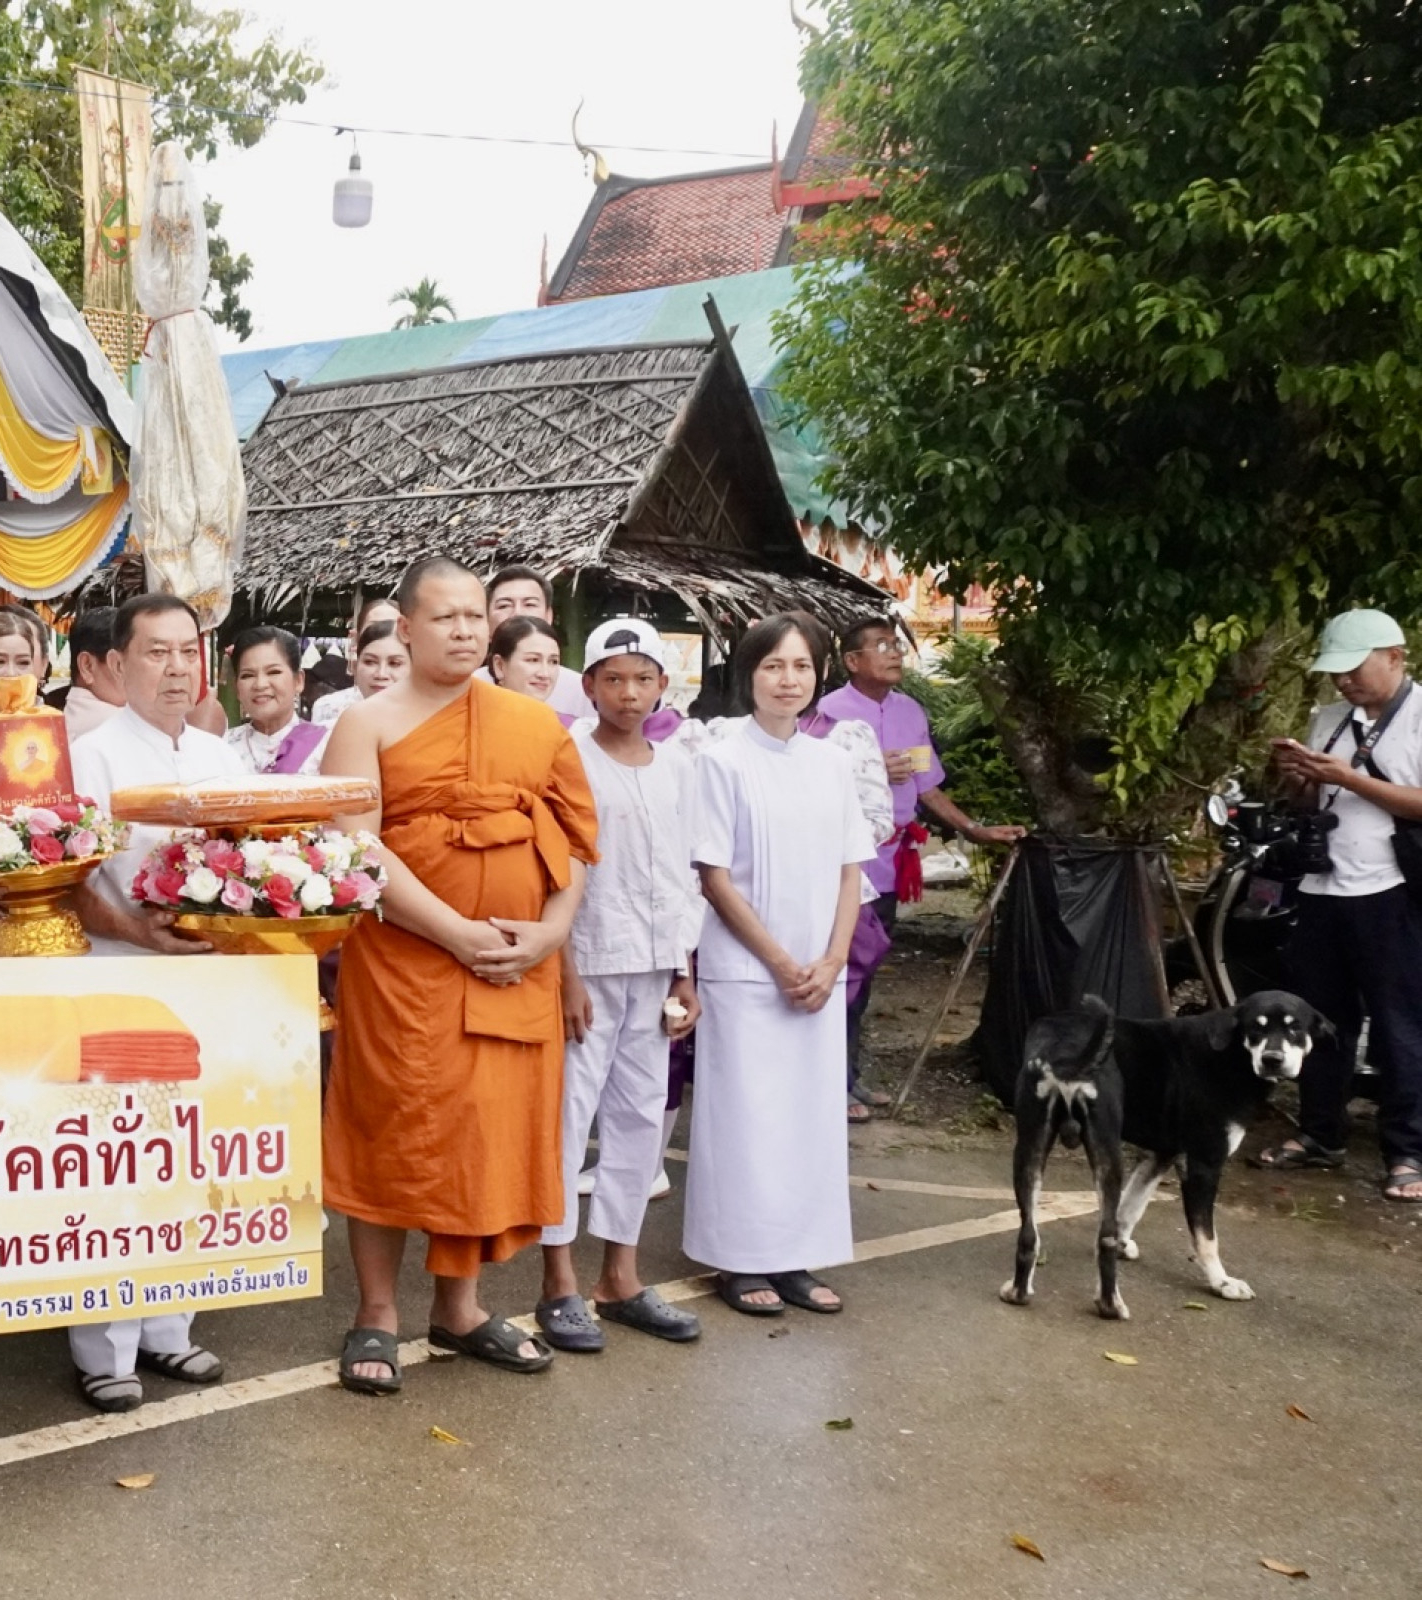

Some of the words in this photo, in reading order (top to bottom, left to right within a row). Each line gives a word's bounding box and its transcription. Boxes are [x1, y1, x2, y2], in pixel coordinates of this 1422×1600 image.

[197, 1208, 289, 1249] 2568
[82, 1288, 109, 1310] 81
[118, 1281, 135, 1308] ปี
[143, 1265, 308, 1305] หลวงพ่อธัมมชโย
